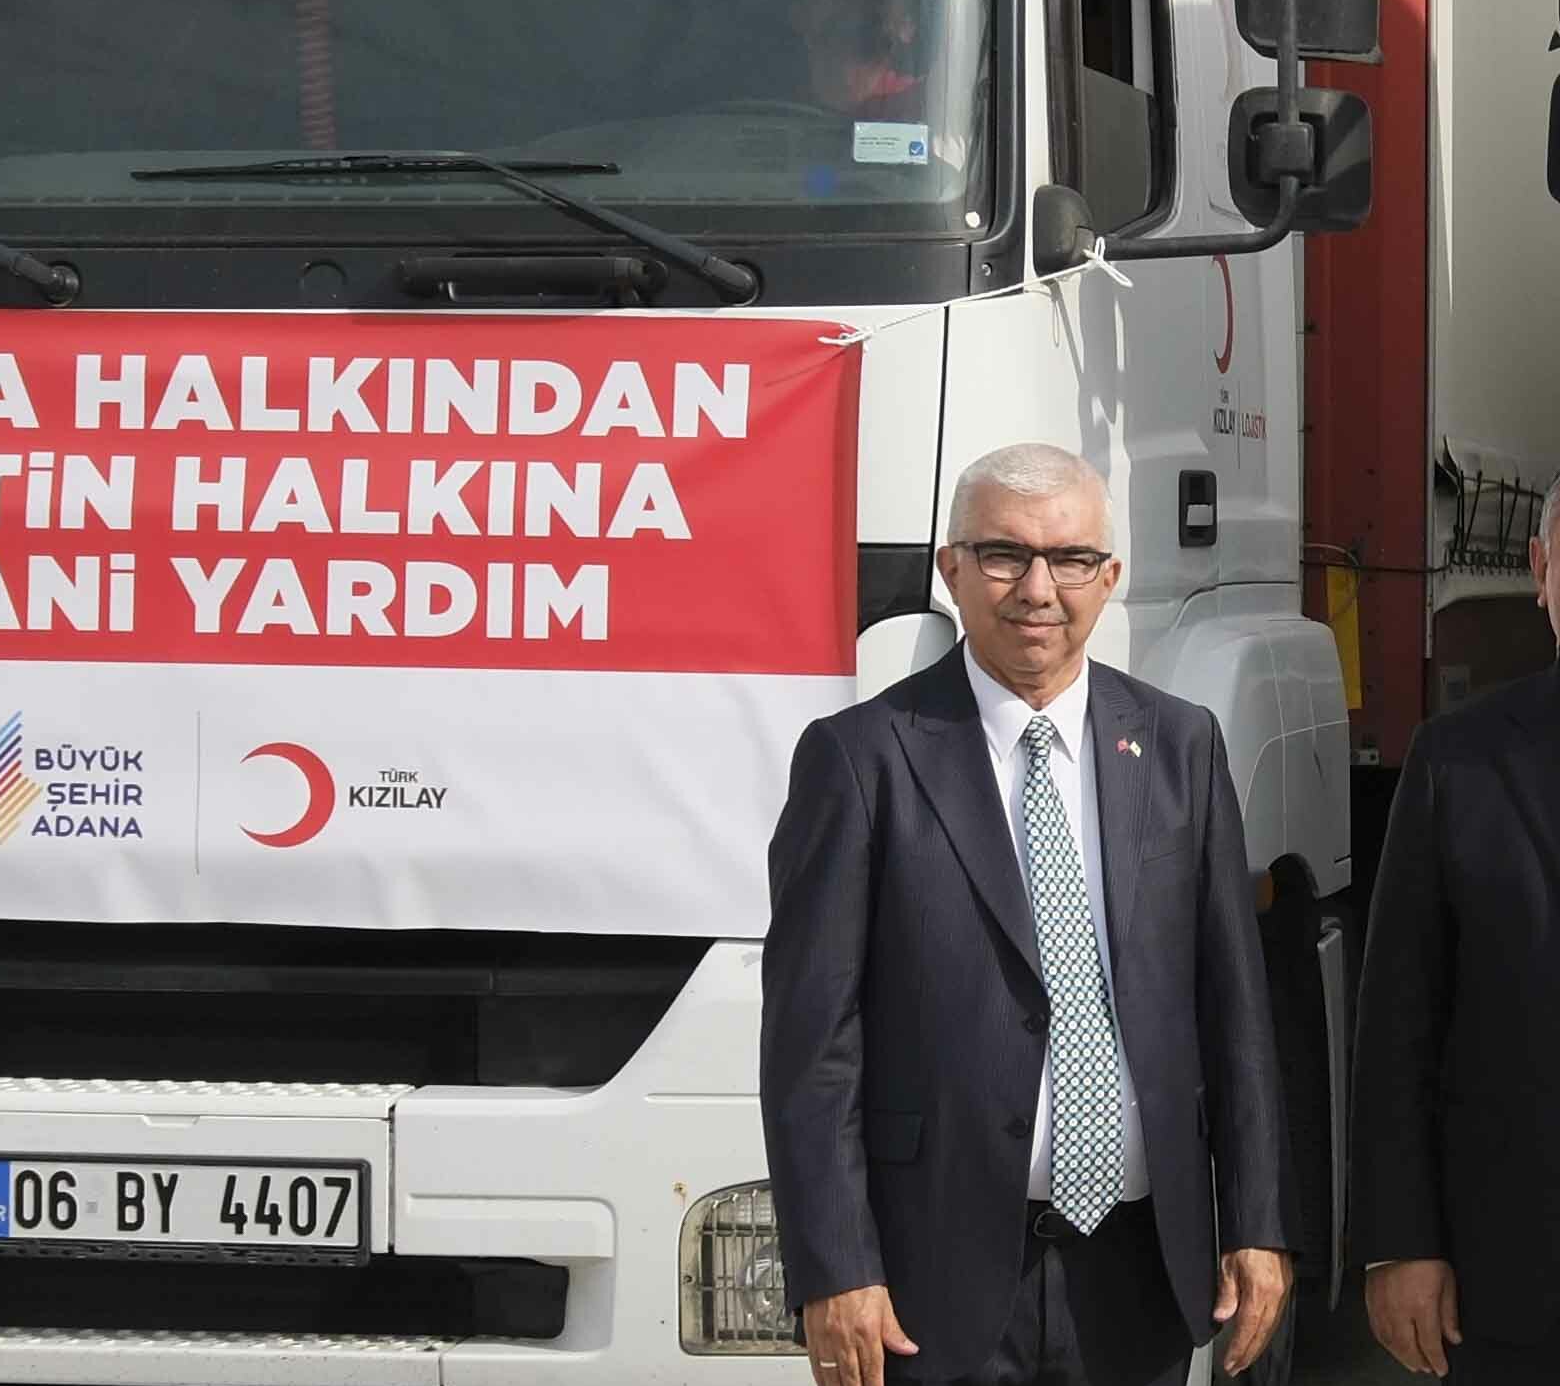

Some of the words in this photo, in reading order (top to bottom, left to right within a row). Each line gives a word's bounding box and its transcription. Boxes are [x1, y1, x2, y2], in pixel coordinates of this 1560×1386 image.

[75, 354, 750, 439] HALKINDAN
[173, 457, 692, 540] HALKINA
[171, 558, 608, 641] YARDIM
[35, 745, 143, 772] BÜYÜK
[379, 769, 418, 783] TÜRK
[47, 778, 143, 813] ŞEHİR
[349, 786, 447, 809] KIZILAY
[32, 815, 143, 838] ADANA
[15, 1170, 78, 1230] 06
[117, 1171, 179, 1233] BY
[220, 1174, 352, 1238] 4407
